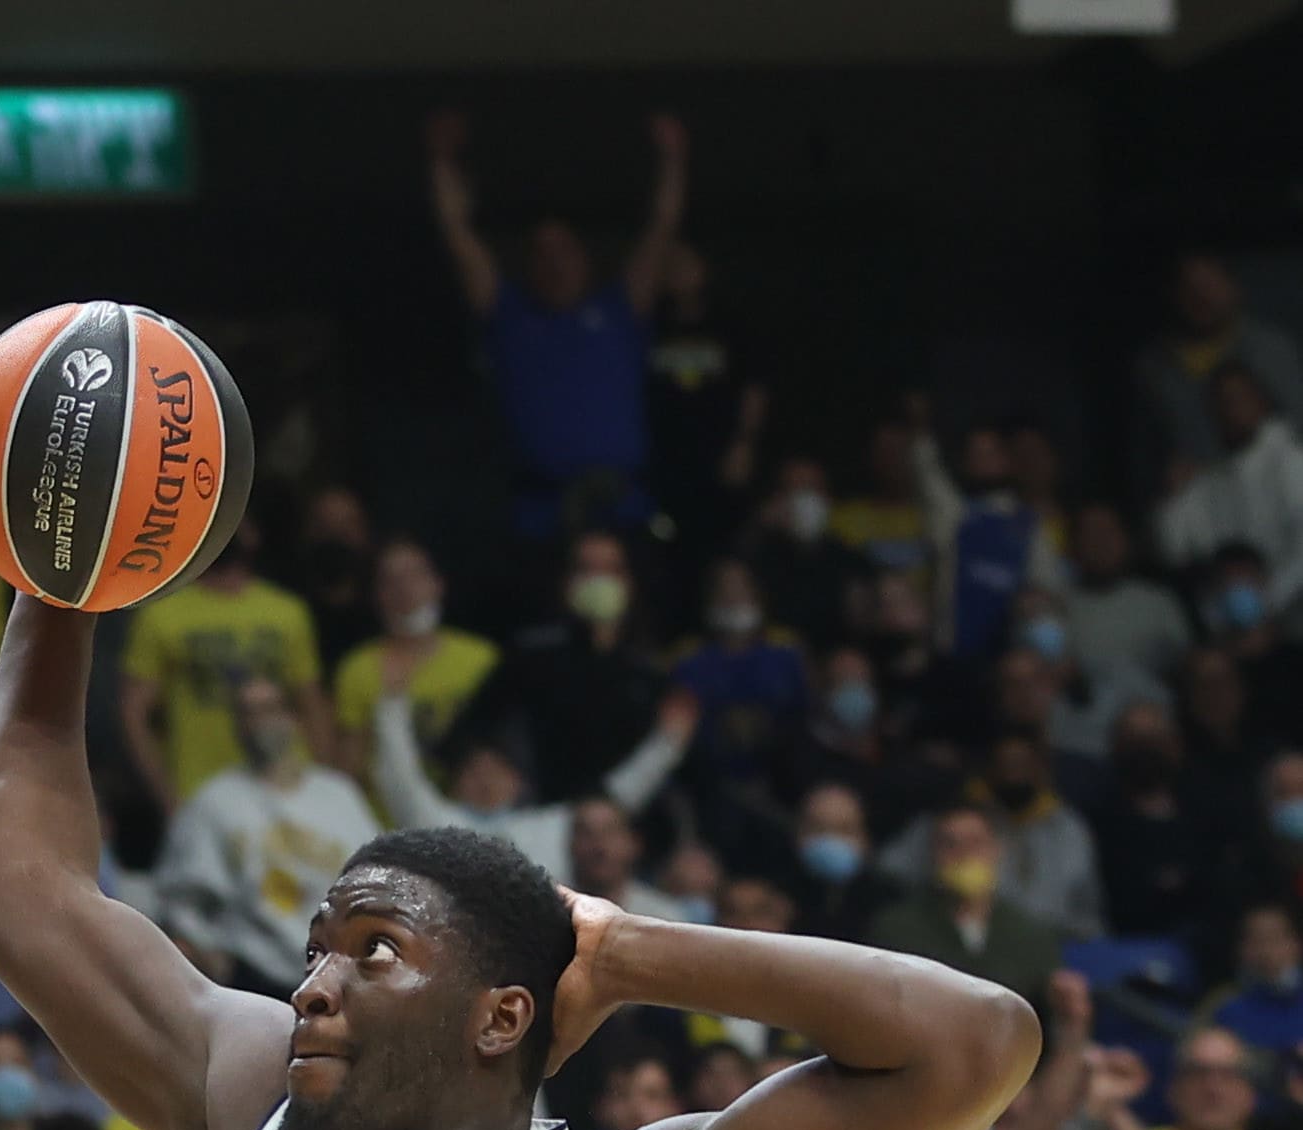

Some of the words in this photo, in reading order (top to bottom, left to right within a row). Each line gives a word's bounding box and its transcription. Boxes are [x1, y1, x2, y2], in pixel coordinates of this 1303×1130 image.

[32, 394, 76, 532] EuroLeague
[62, 400, 96, 489] TURKISH
[119, 366, 194, 574] SPALDING
[54, 491, 77, 572] AIRLINES
